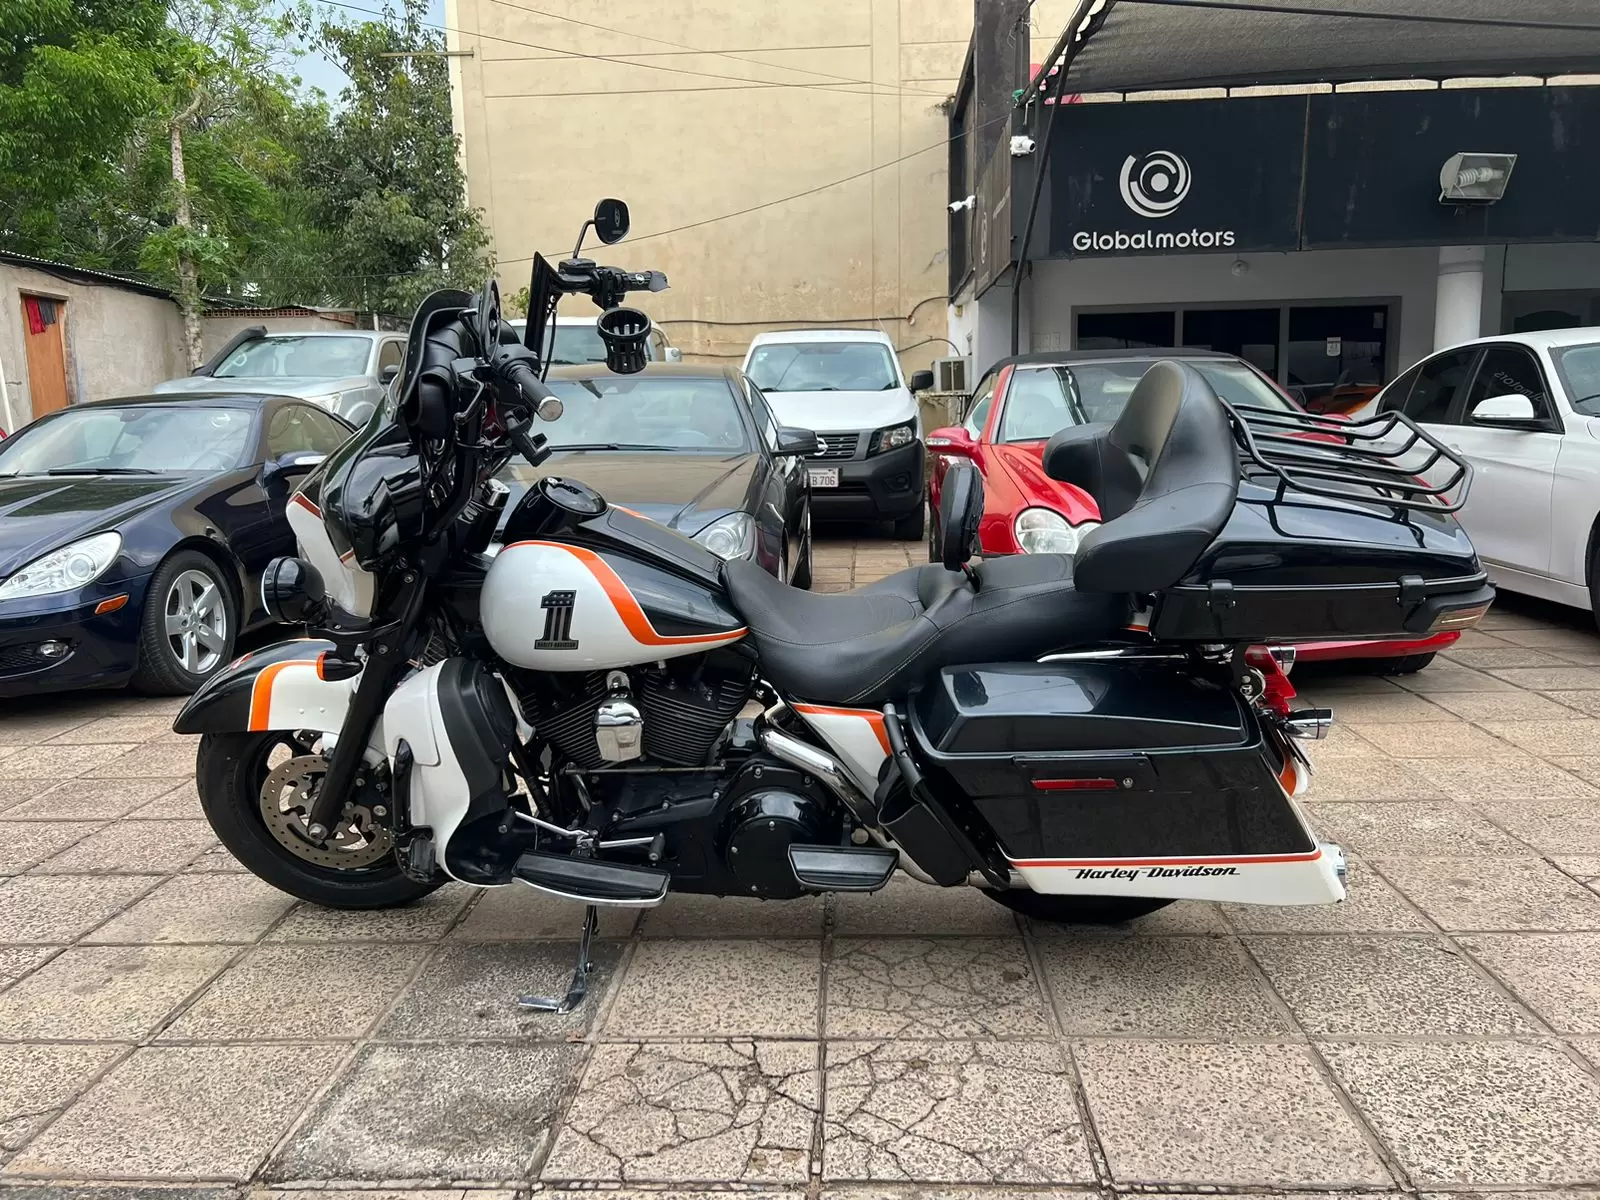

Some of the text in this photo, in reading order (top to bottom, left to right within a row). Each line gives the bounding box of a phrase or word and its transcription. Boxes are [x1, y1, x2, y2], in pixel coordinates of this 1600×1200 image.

[1072, 228, 1235, 251] Globalmotors
[819, 475, 836, 486] 706
[1068, 866, 1240, 882] Harley-Davidson
